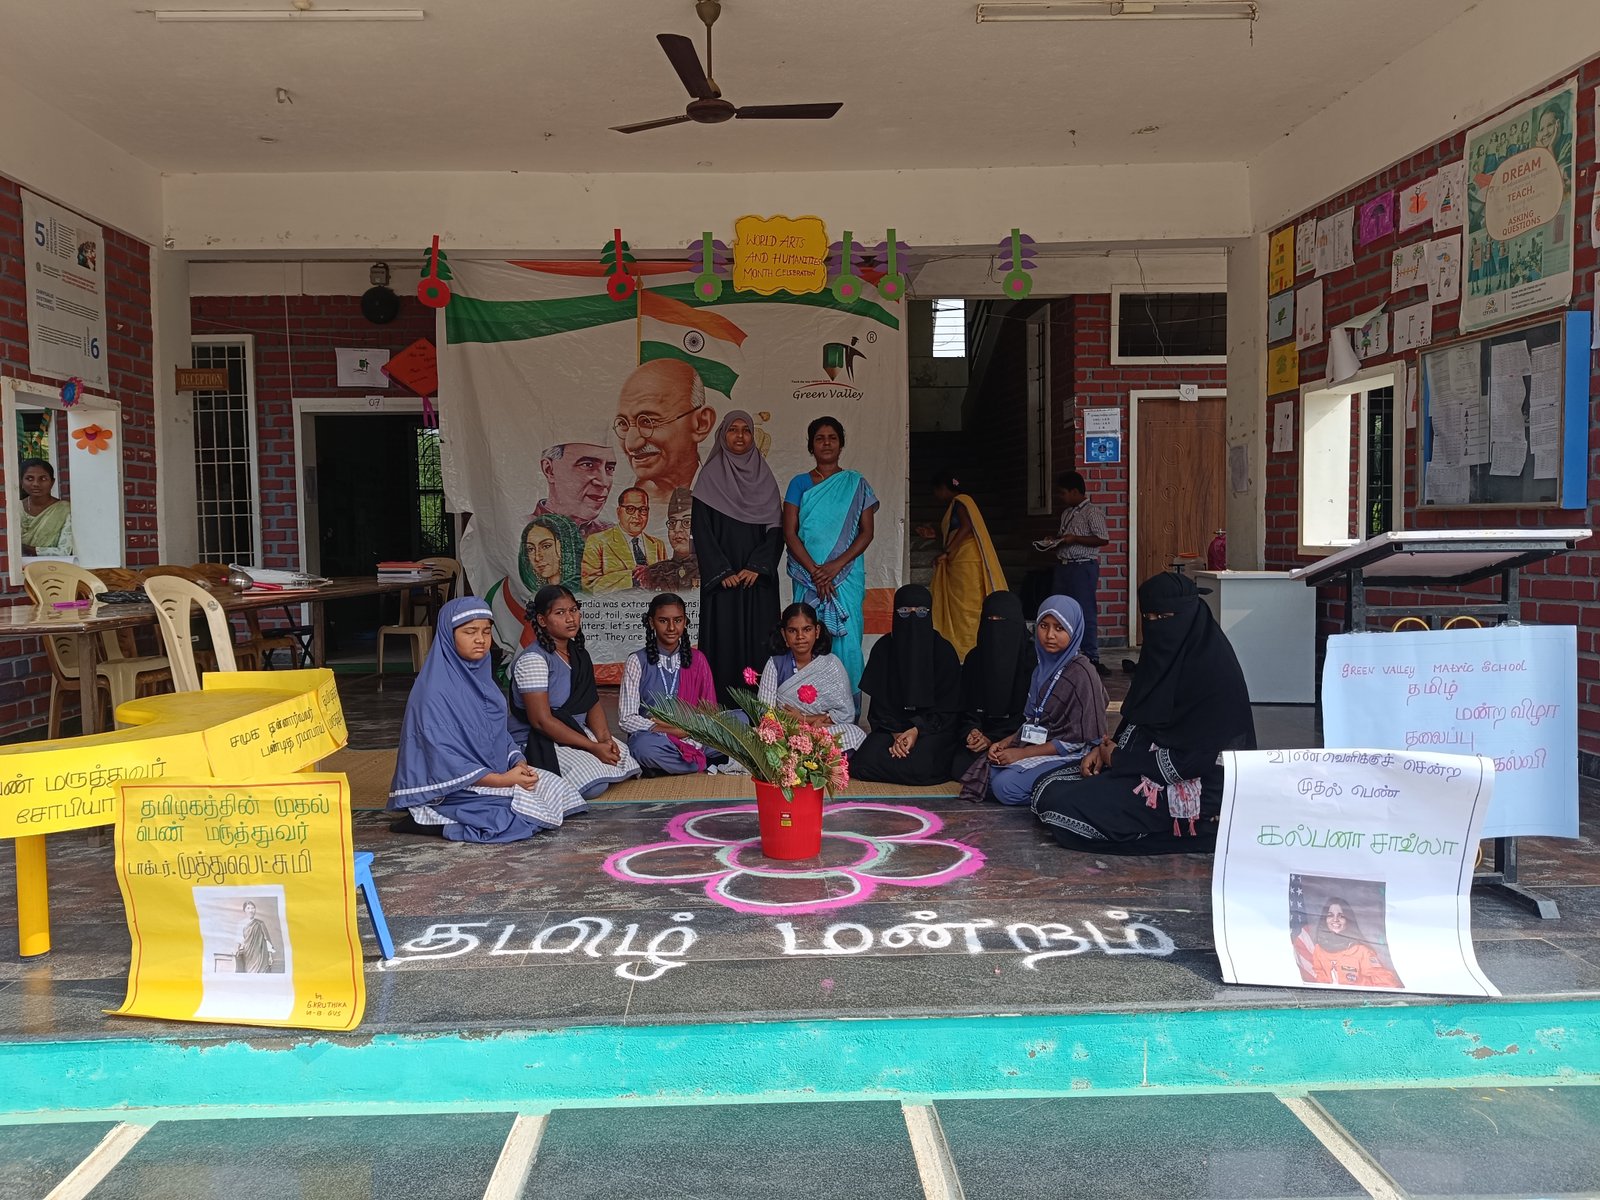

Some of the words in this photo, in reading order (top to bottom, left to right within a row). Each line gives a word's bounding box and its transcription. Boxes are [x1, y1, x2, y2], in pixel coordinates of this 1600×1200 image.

[1502, 157, 1541, 184] DREAM
[1502, 216, 1541, 236] QUESTIONS
[1507, 210, 1534, 226] ASKING
[35, 221, 46, 247] 5
[746, 233, 777, 247] WORLD
[779, 235, 806, 248] ARTS
[745, 251, 769, 263] AND
[743, 267, 773, 280] MONTH
[90, 337, 100, 359] 6
[180, 373, 224, 386] RECEPTION
[792, 390, 828, 400] Green
[829, 389, 864, 401] Valley
[580, 611, 603, 620] lood,
[605, 632, 626, 642] They
[1406, 676, 1459, 706] தமிழ்
[1405, 727, 1474, 751] தலைப்பு
[1403, 758, 1462, 782] சென்ற
[1297, 777, 1343, 800] முதல்
[1351, 784, 1400, 798] பெண்
[140, 793, 260, 823] தமிழகத்தின்
[274, 793, 330, 820] முதல்
[136, 820, 185, 842] பெண்
[204, 821, 309, 848] மருத்துவர்
[1257, 823, 1366, 850] கல்பனா
[1369, 832, 1459, 855] சாவ்லா
[376, 911, 698, 982] தமிழ்
[776, 909, 1179, 972] மன்றம்
